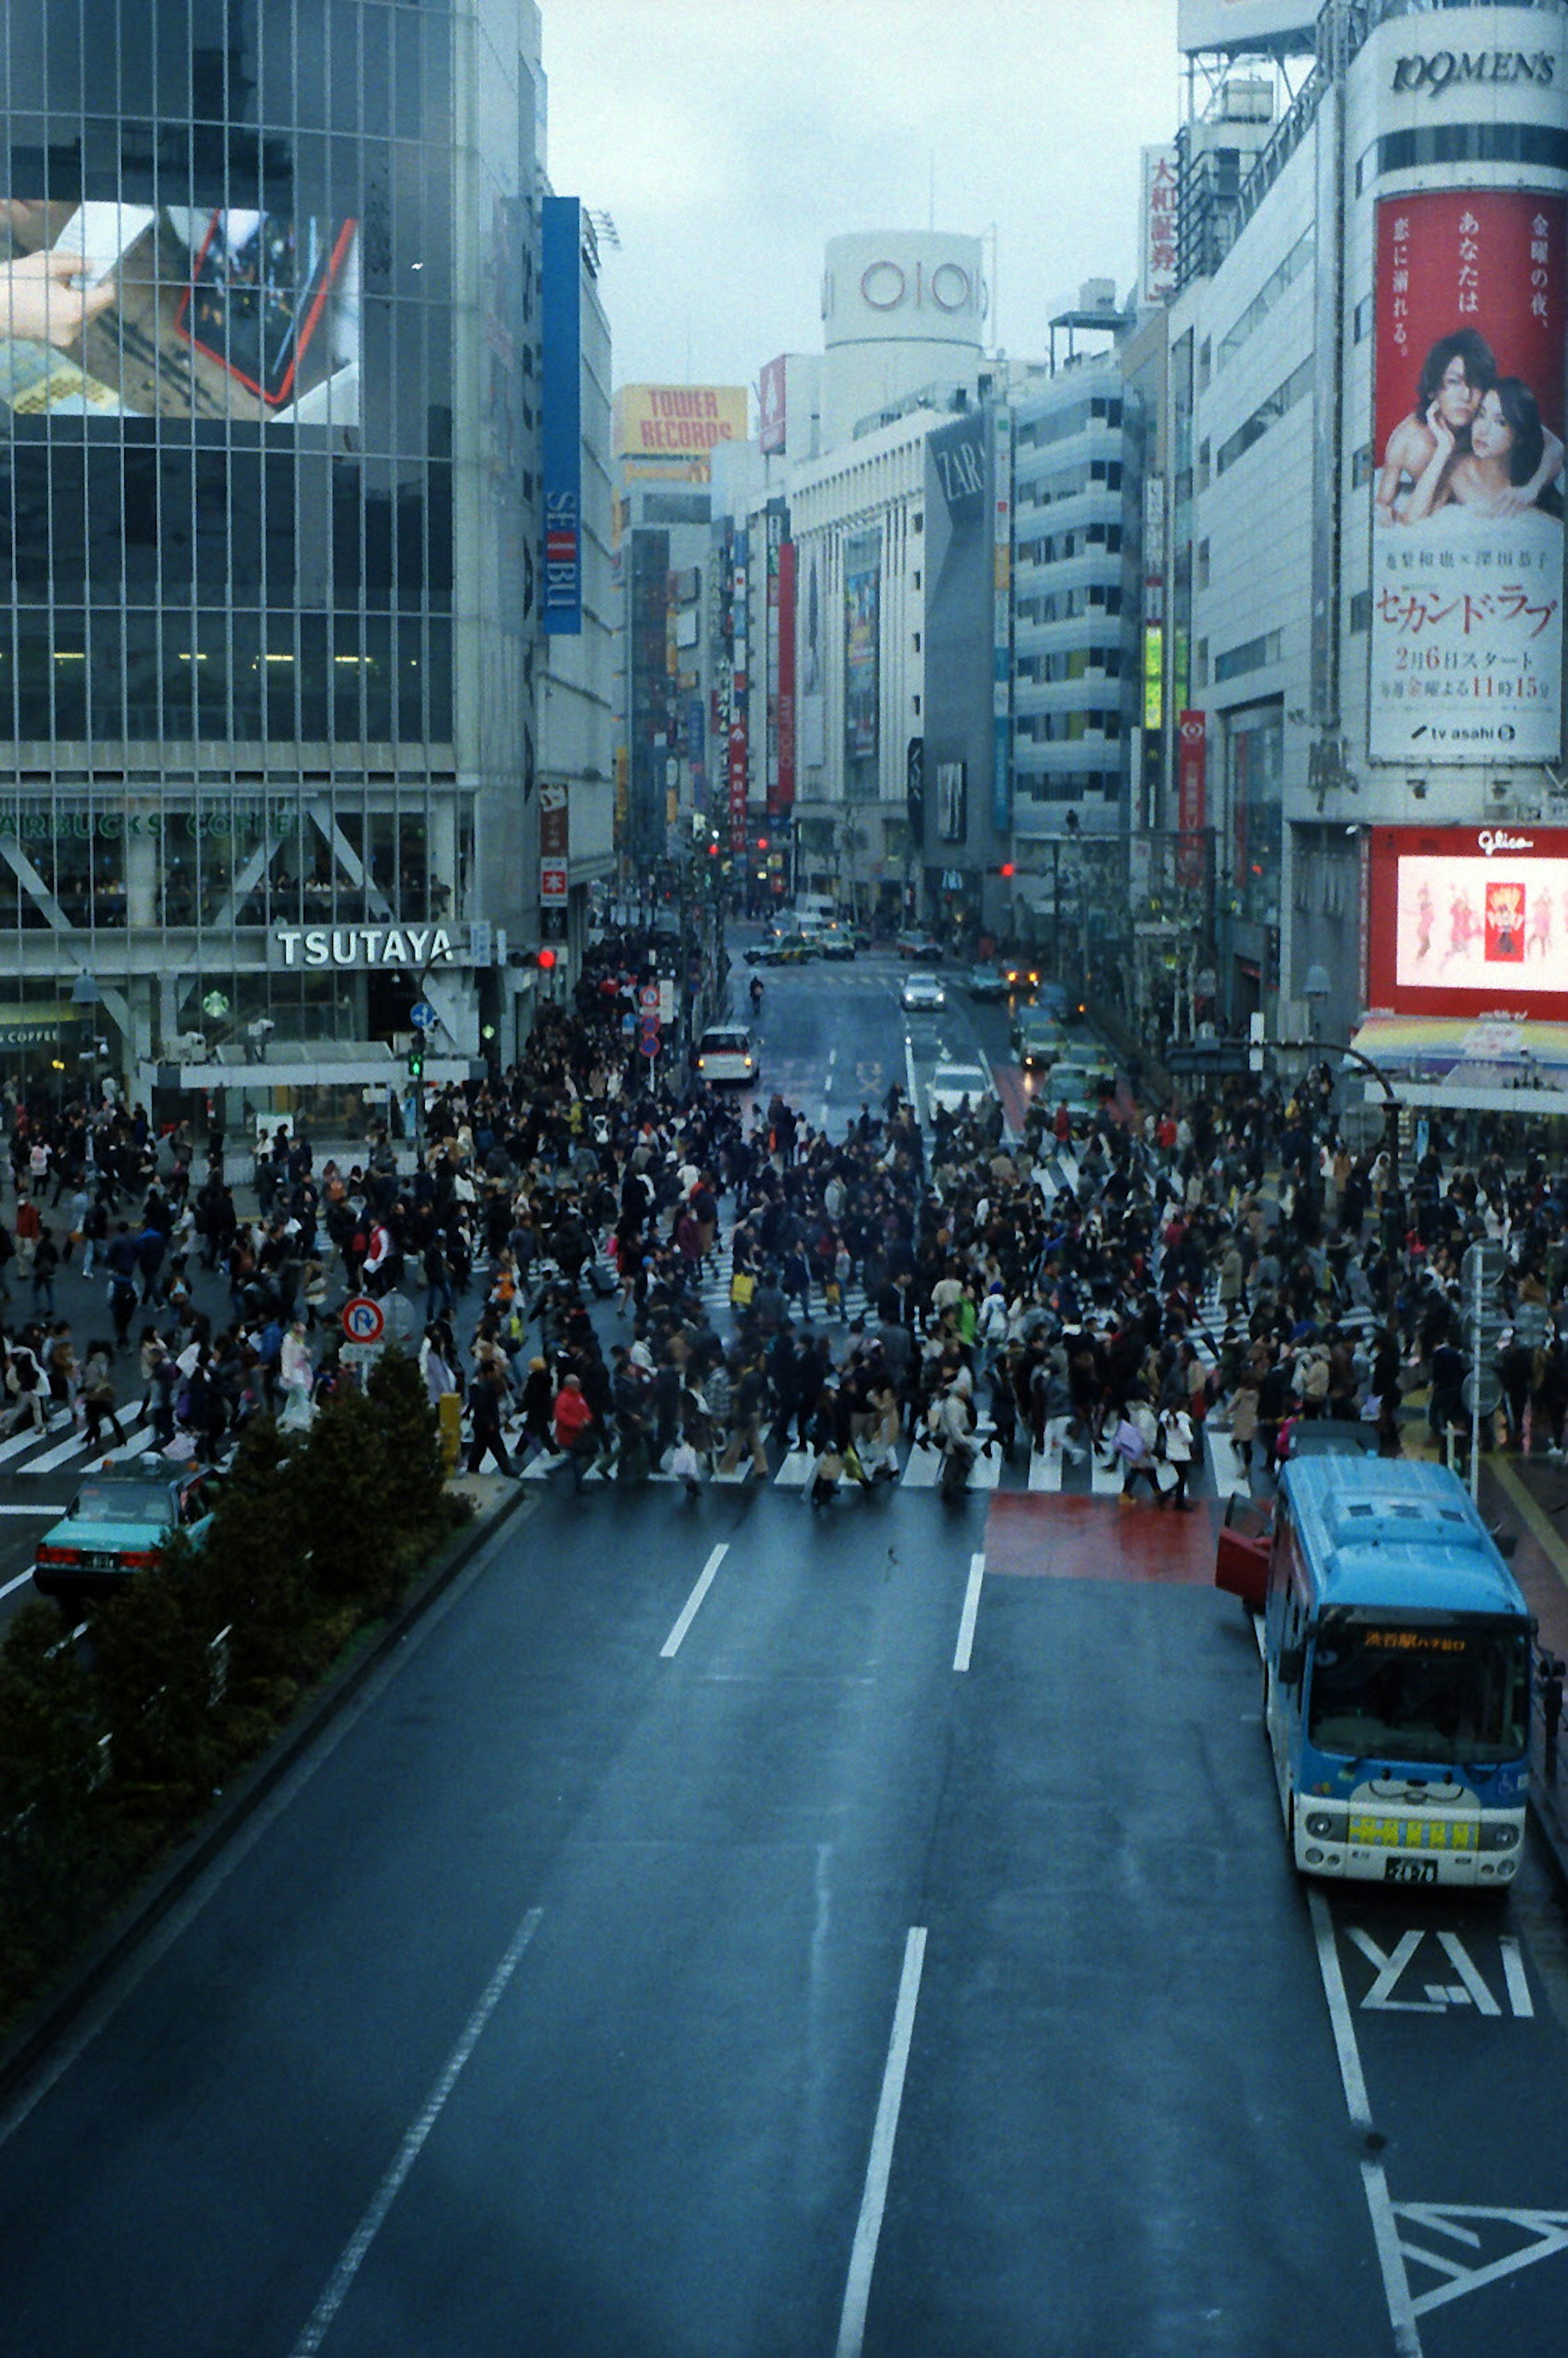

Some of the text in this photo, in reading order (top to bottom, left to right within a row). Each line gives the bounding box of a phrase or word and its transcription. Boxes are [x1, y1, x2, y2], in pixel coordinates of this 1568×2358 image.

[1458, 211, 1479, 313] あなたは
[648, 390, 719, 419] TOWER
[640, 420, 735, 448] RECORDS
[547, 491, 577, 606] SEIBU
[1395, 646, 1532, 671] 2月6日スタート
[1431, 726, 1494, 740] tv asahi
[277, 929, 454, 965] TSUTAYA
